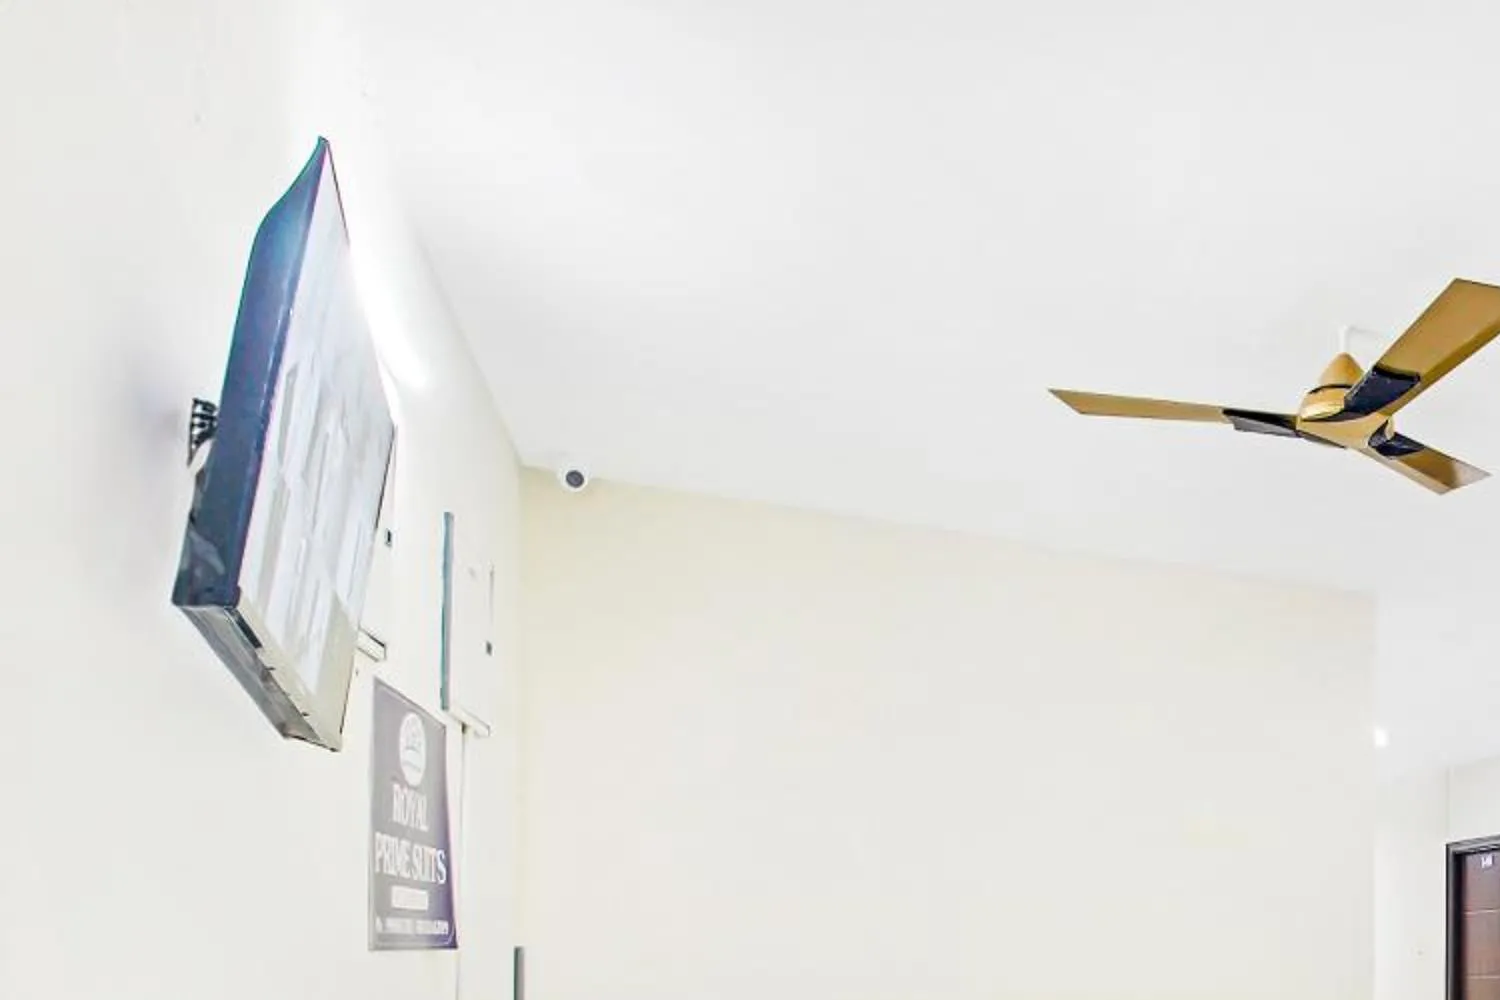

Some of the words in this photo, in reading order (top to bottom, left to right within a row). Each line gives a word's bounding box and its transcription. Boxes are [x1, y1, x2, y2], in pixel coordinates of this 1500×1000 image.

[393, 784, 429, 832] ROYAL
[375, 831, 411, 879] PRIME
[412, 843, 447, 884] SUITS
